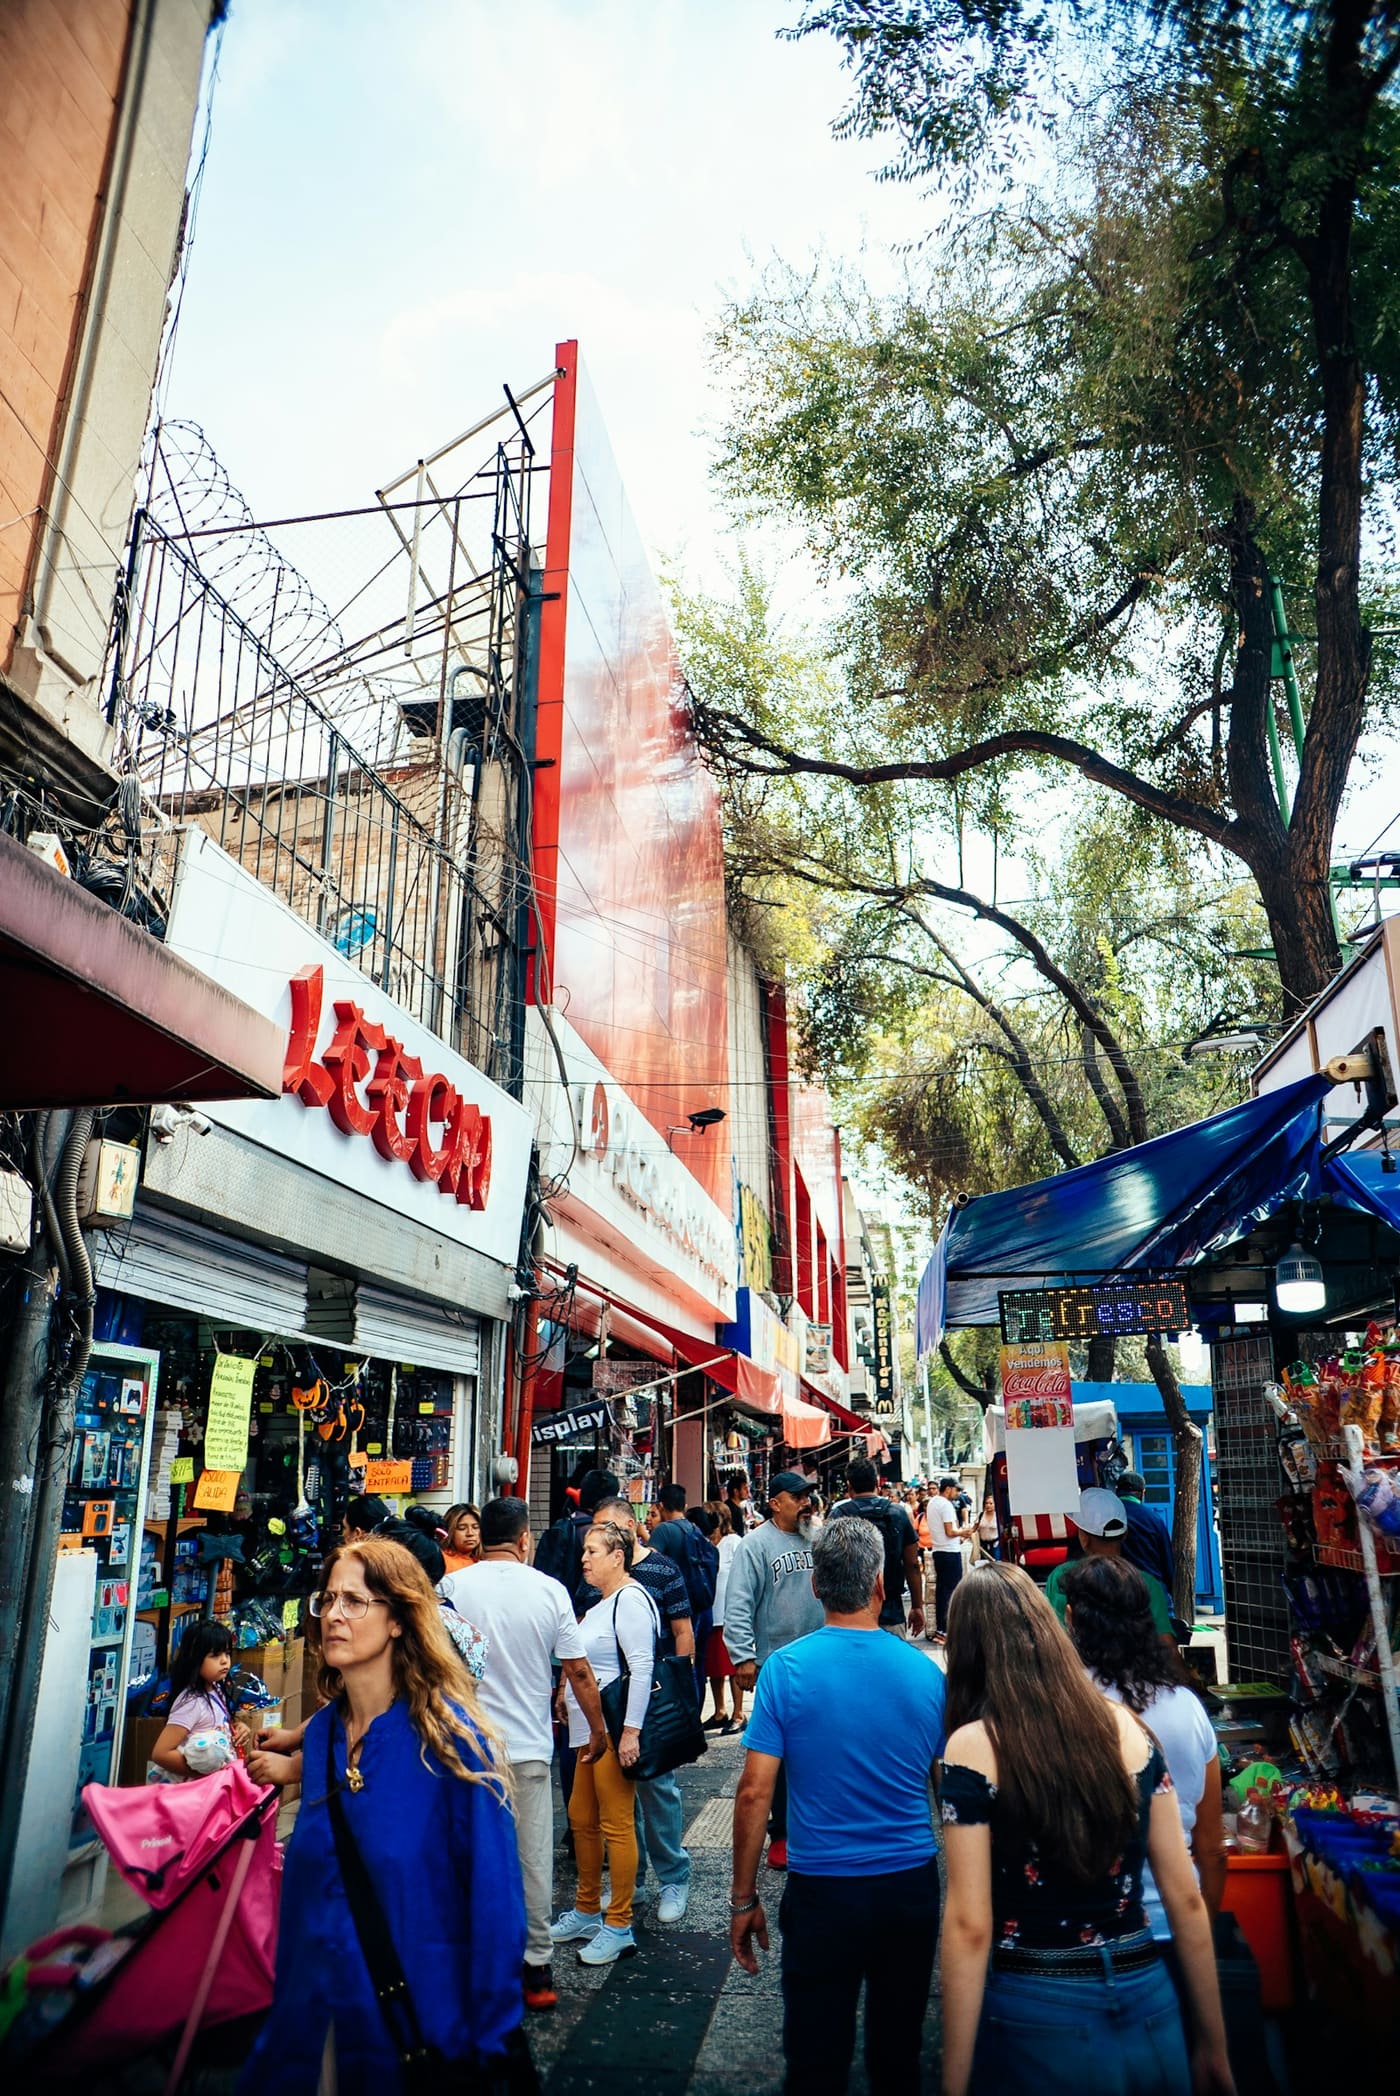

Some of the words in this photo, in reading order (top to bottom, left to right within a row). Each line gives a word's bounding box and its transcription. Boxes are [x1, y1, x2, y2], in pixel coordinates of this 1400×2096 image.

[1018, 1299, 1173, 1328] refresco
[875, 1297, 892, 1389] McDonald's
[1007, 1357, 1063, 1370] Vendemos
[532, 1410, 605, 1442] isplay
